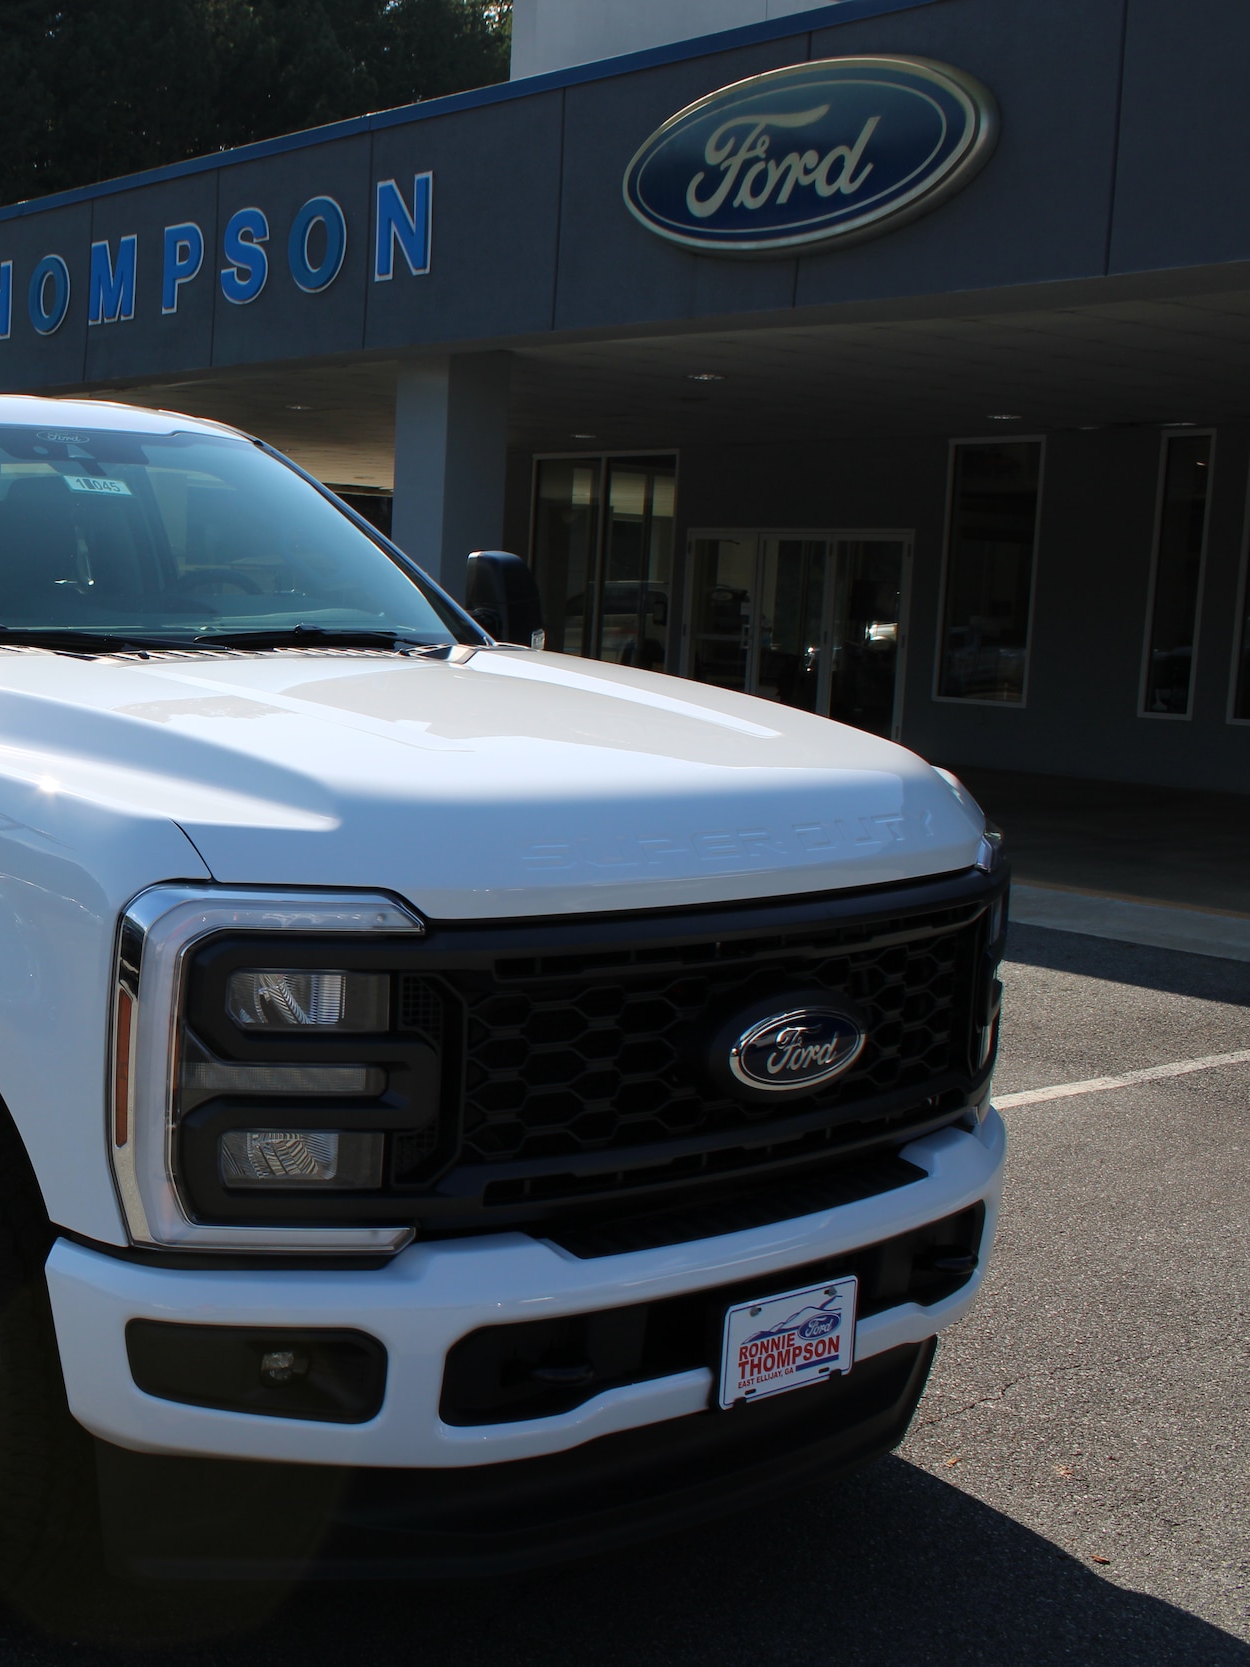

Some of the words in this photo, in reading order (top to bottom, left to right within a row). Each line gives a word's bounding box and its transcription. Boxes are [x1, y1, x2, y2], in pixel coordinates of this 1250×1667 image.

[687, 104, 881, 218] Ford
[47, 431, 83, 443] Ford
[521, 827, 789, 870] SUPER
[791, 809, 934, 852] DUTY
[767, 1024, 839, 1074] Ford
[804, 1317, 834, 1338] Ford
[738, 1333, 795, 1361] RONNIE
[738, 1335, 840, 1380] THOMPSON
[738, 1378, 755, 1389] EAST
[785, 1367, 794, 1375] GA
